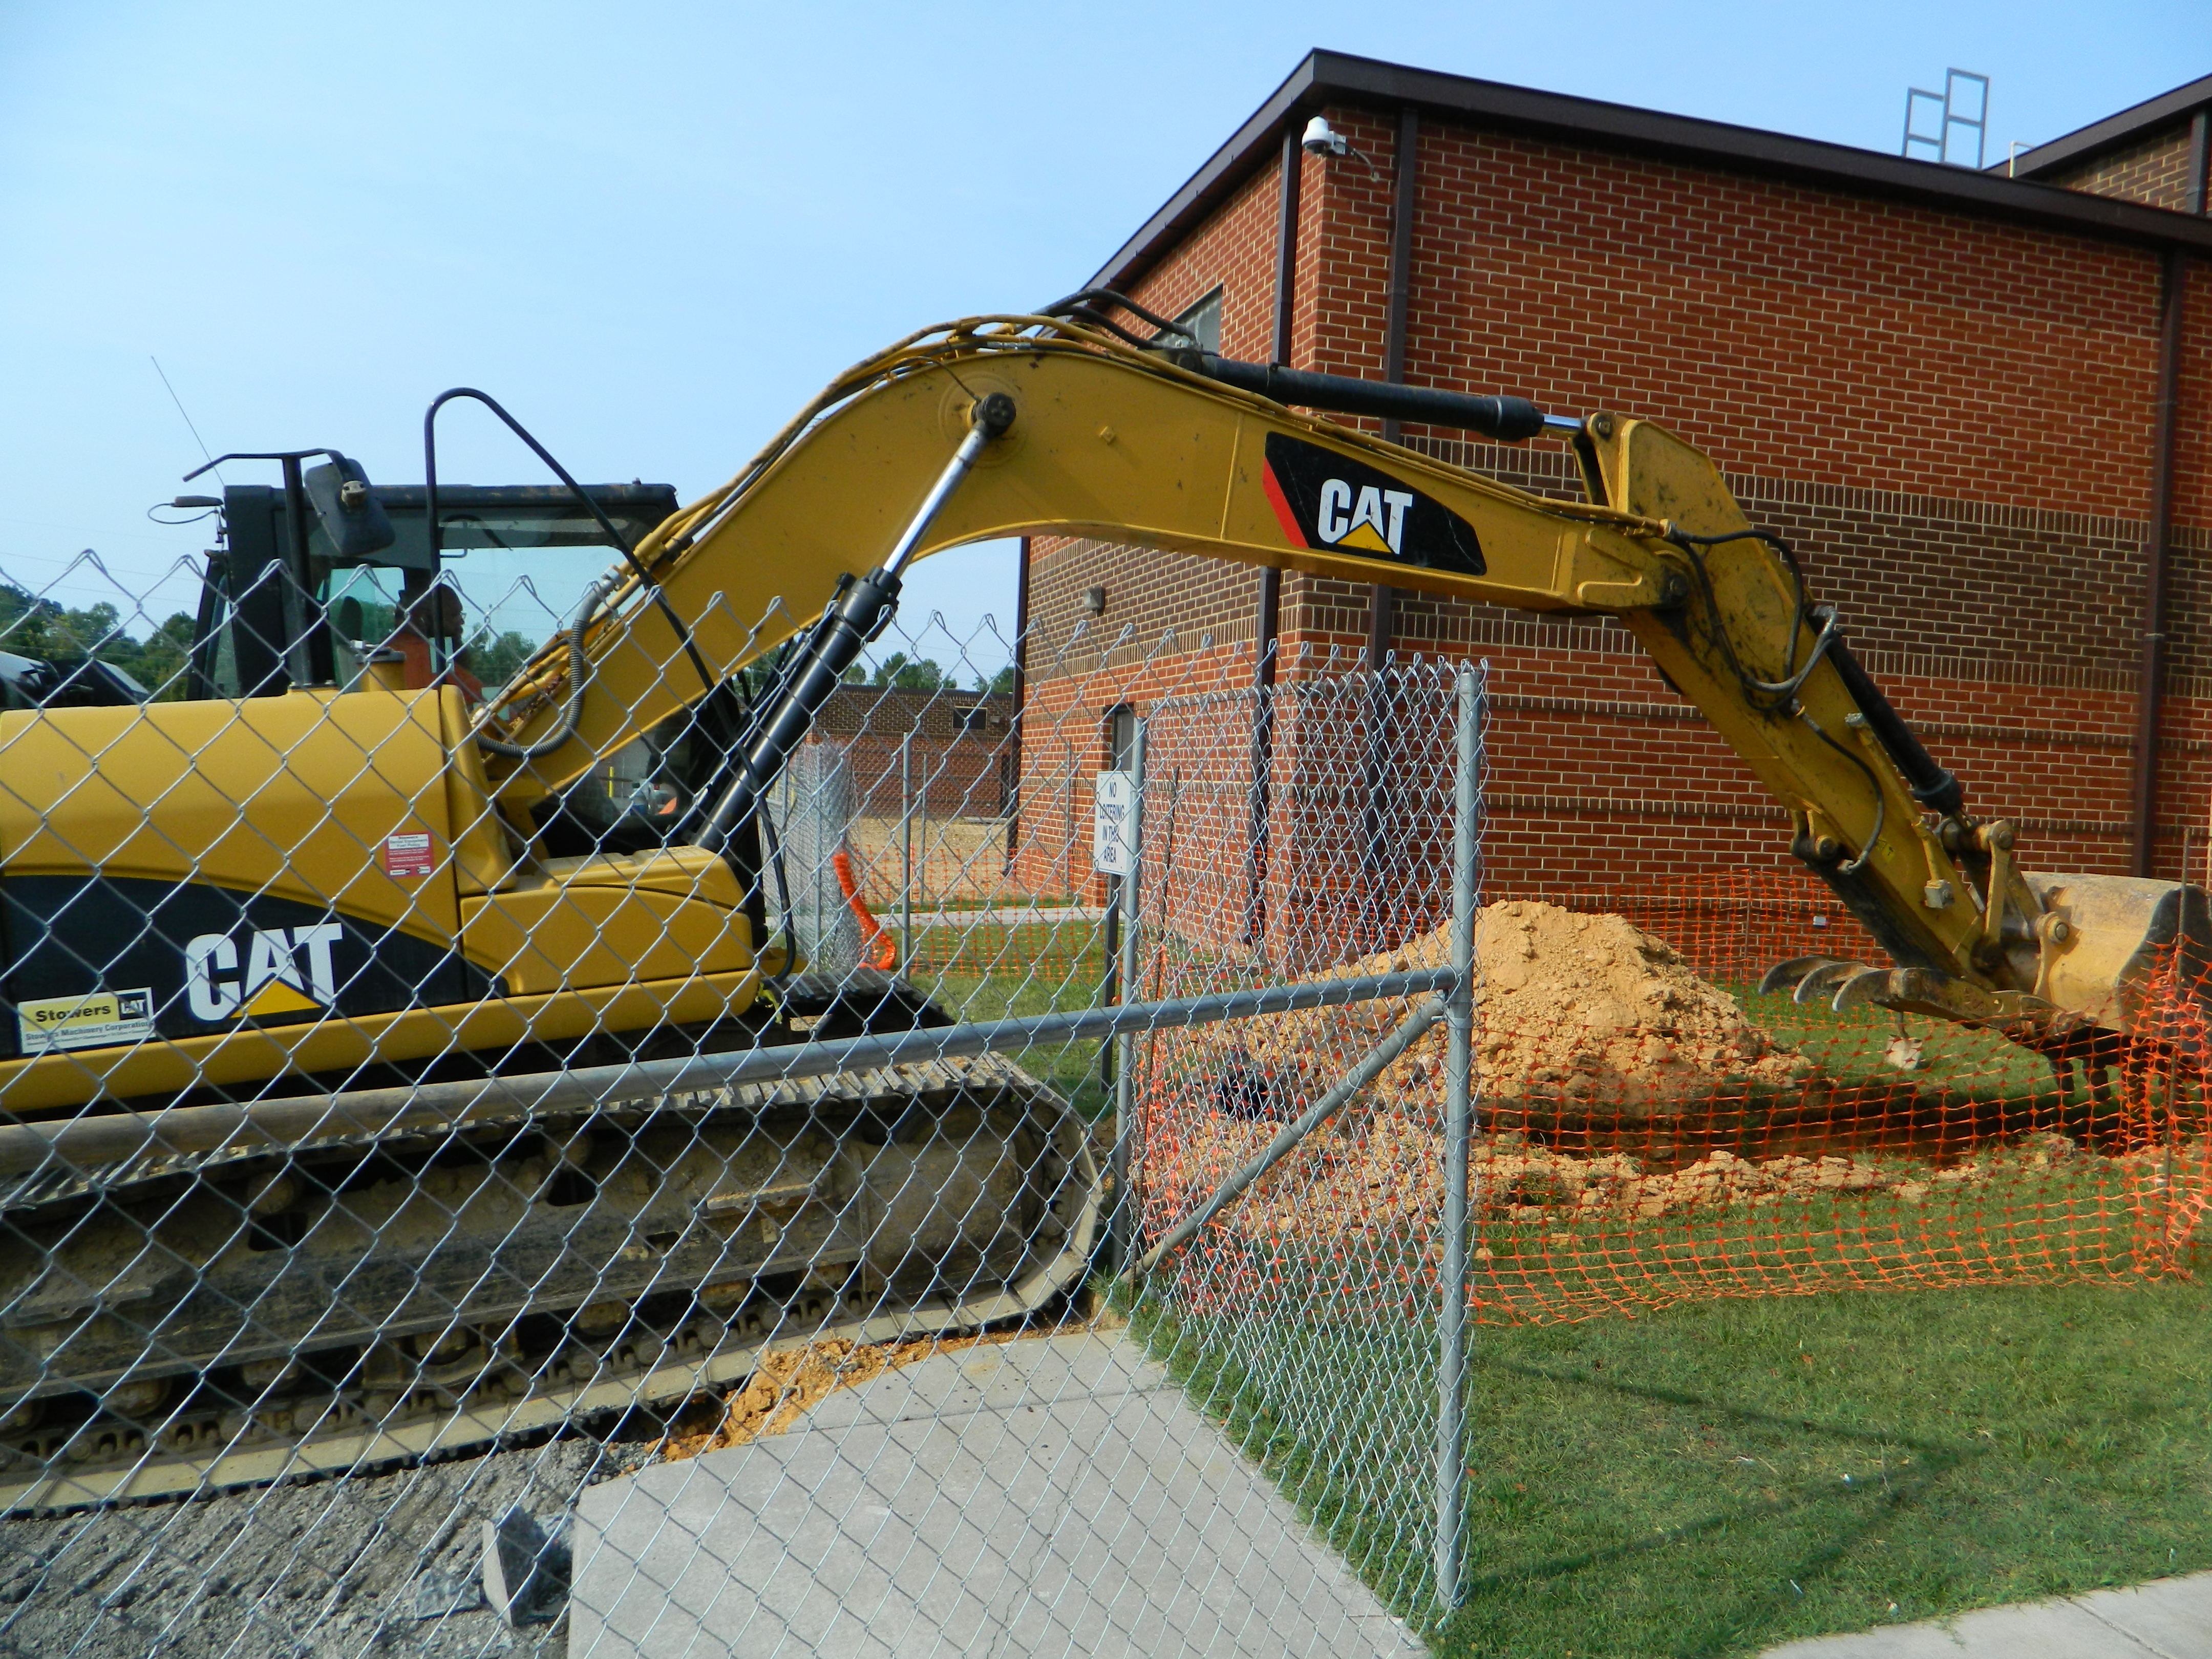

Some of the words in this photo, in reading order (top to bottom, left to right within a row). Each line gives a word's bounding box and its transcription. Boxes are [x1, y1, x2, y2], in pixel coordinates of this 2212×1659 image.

[1318, 479, 1413, 555] CAT
[1109, 781, 1117, 798] NO
[1100, 803, 1125, 820] LOITERING
[1102, 825, 1108, 841] IN
[1103, 846, 1116, 864] AREA
[186, 923, 343, 1021] CAT
[35, 1005, 111, 1022] Stowers
[26, 1032, 59, 1040] Stows
[61, 1027, 103, 1035] Machinery
